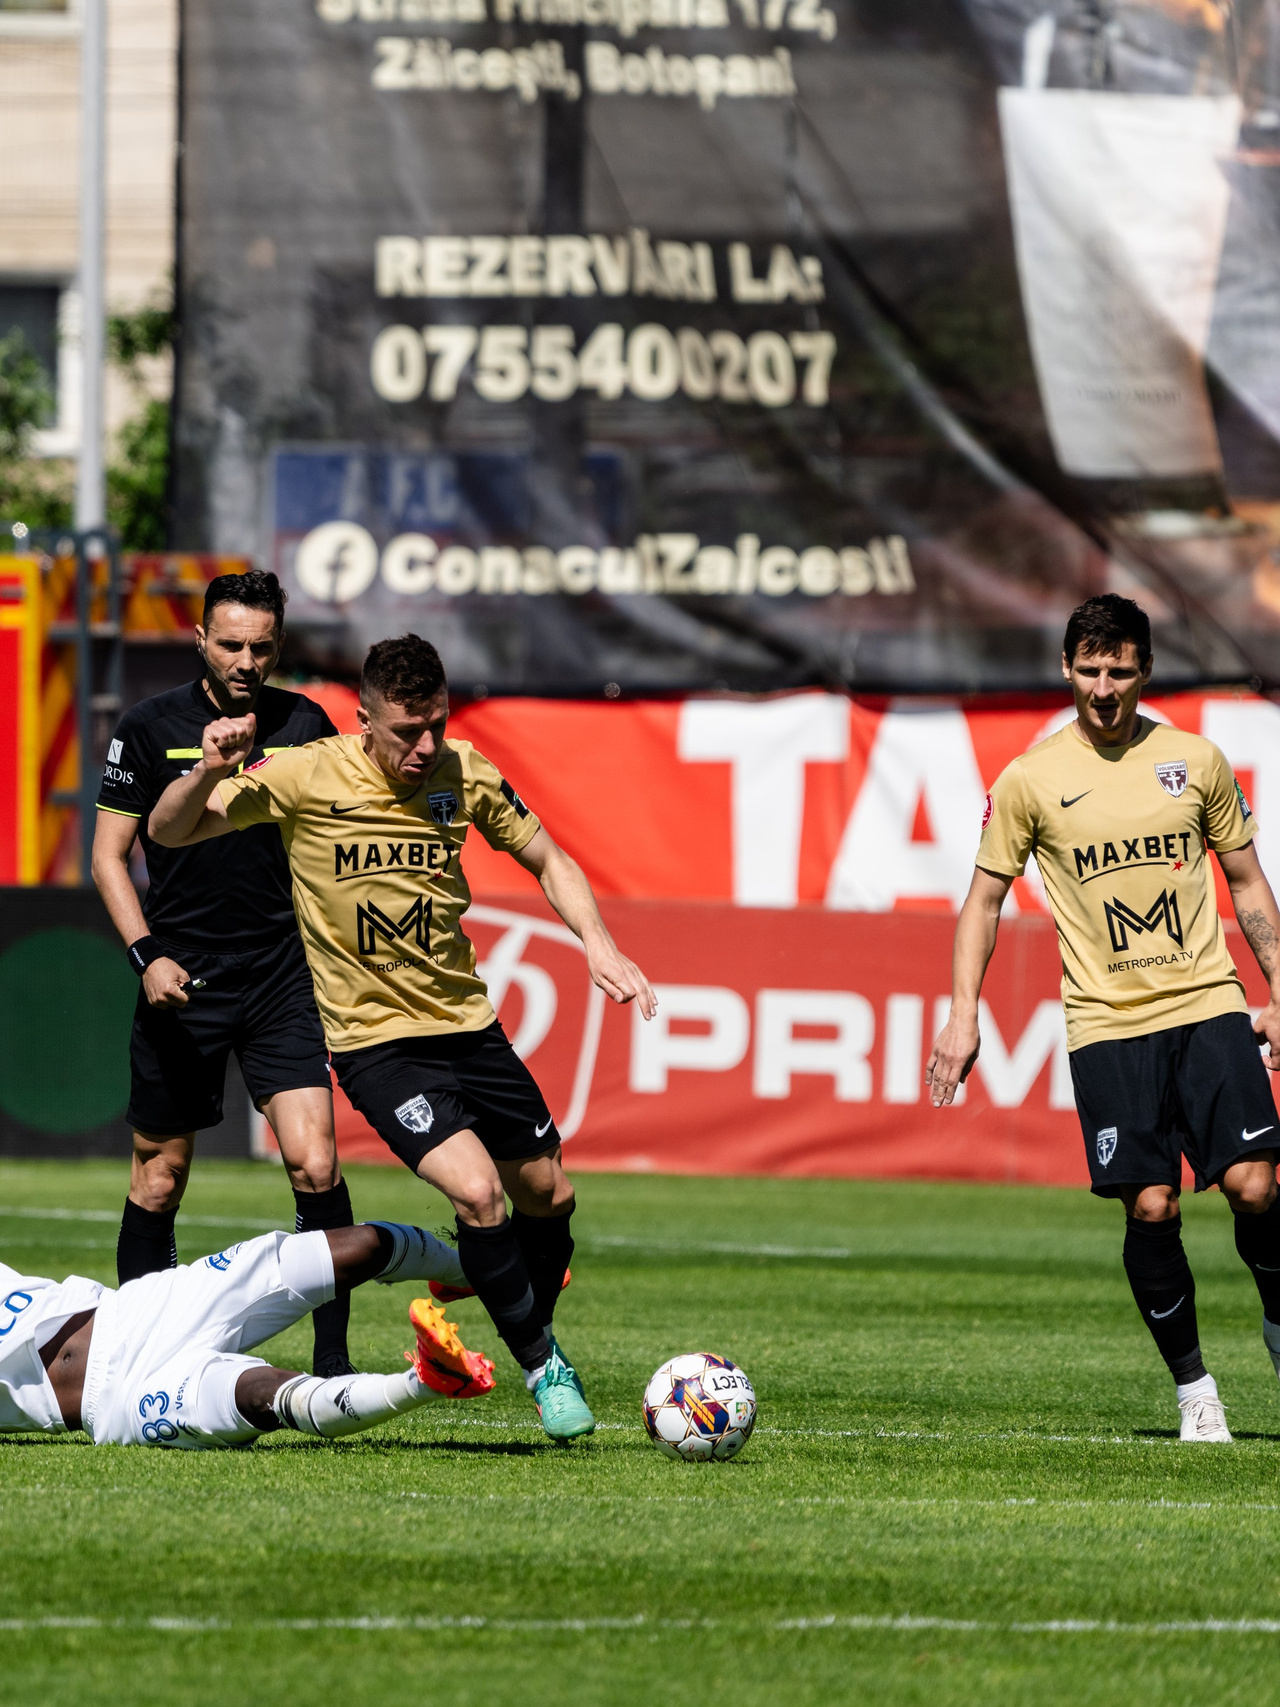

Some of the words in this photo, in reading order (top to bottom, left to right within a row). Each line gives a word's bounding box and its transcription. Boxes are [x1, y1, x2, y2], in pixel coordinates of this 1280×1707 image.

[728, 240, 826, 304] LA:
[370, 322, 837, 406] 0755400207
[334, 842, 456, 876] MAXBET
[1072, 832, 1191, 879] MAXBET
[359, 957, 427, 974] ETROPOLA
[1107, 953, 1179, 974] METROPOLA
[1179, 950, 1194, 961] TV
[631, 984, 1082, 1112] PRIM
[139, 1390, 179, 1443] 83
